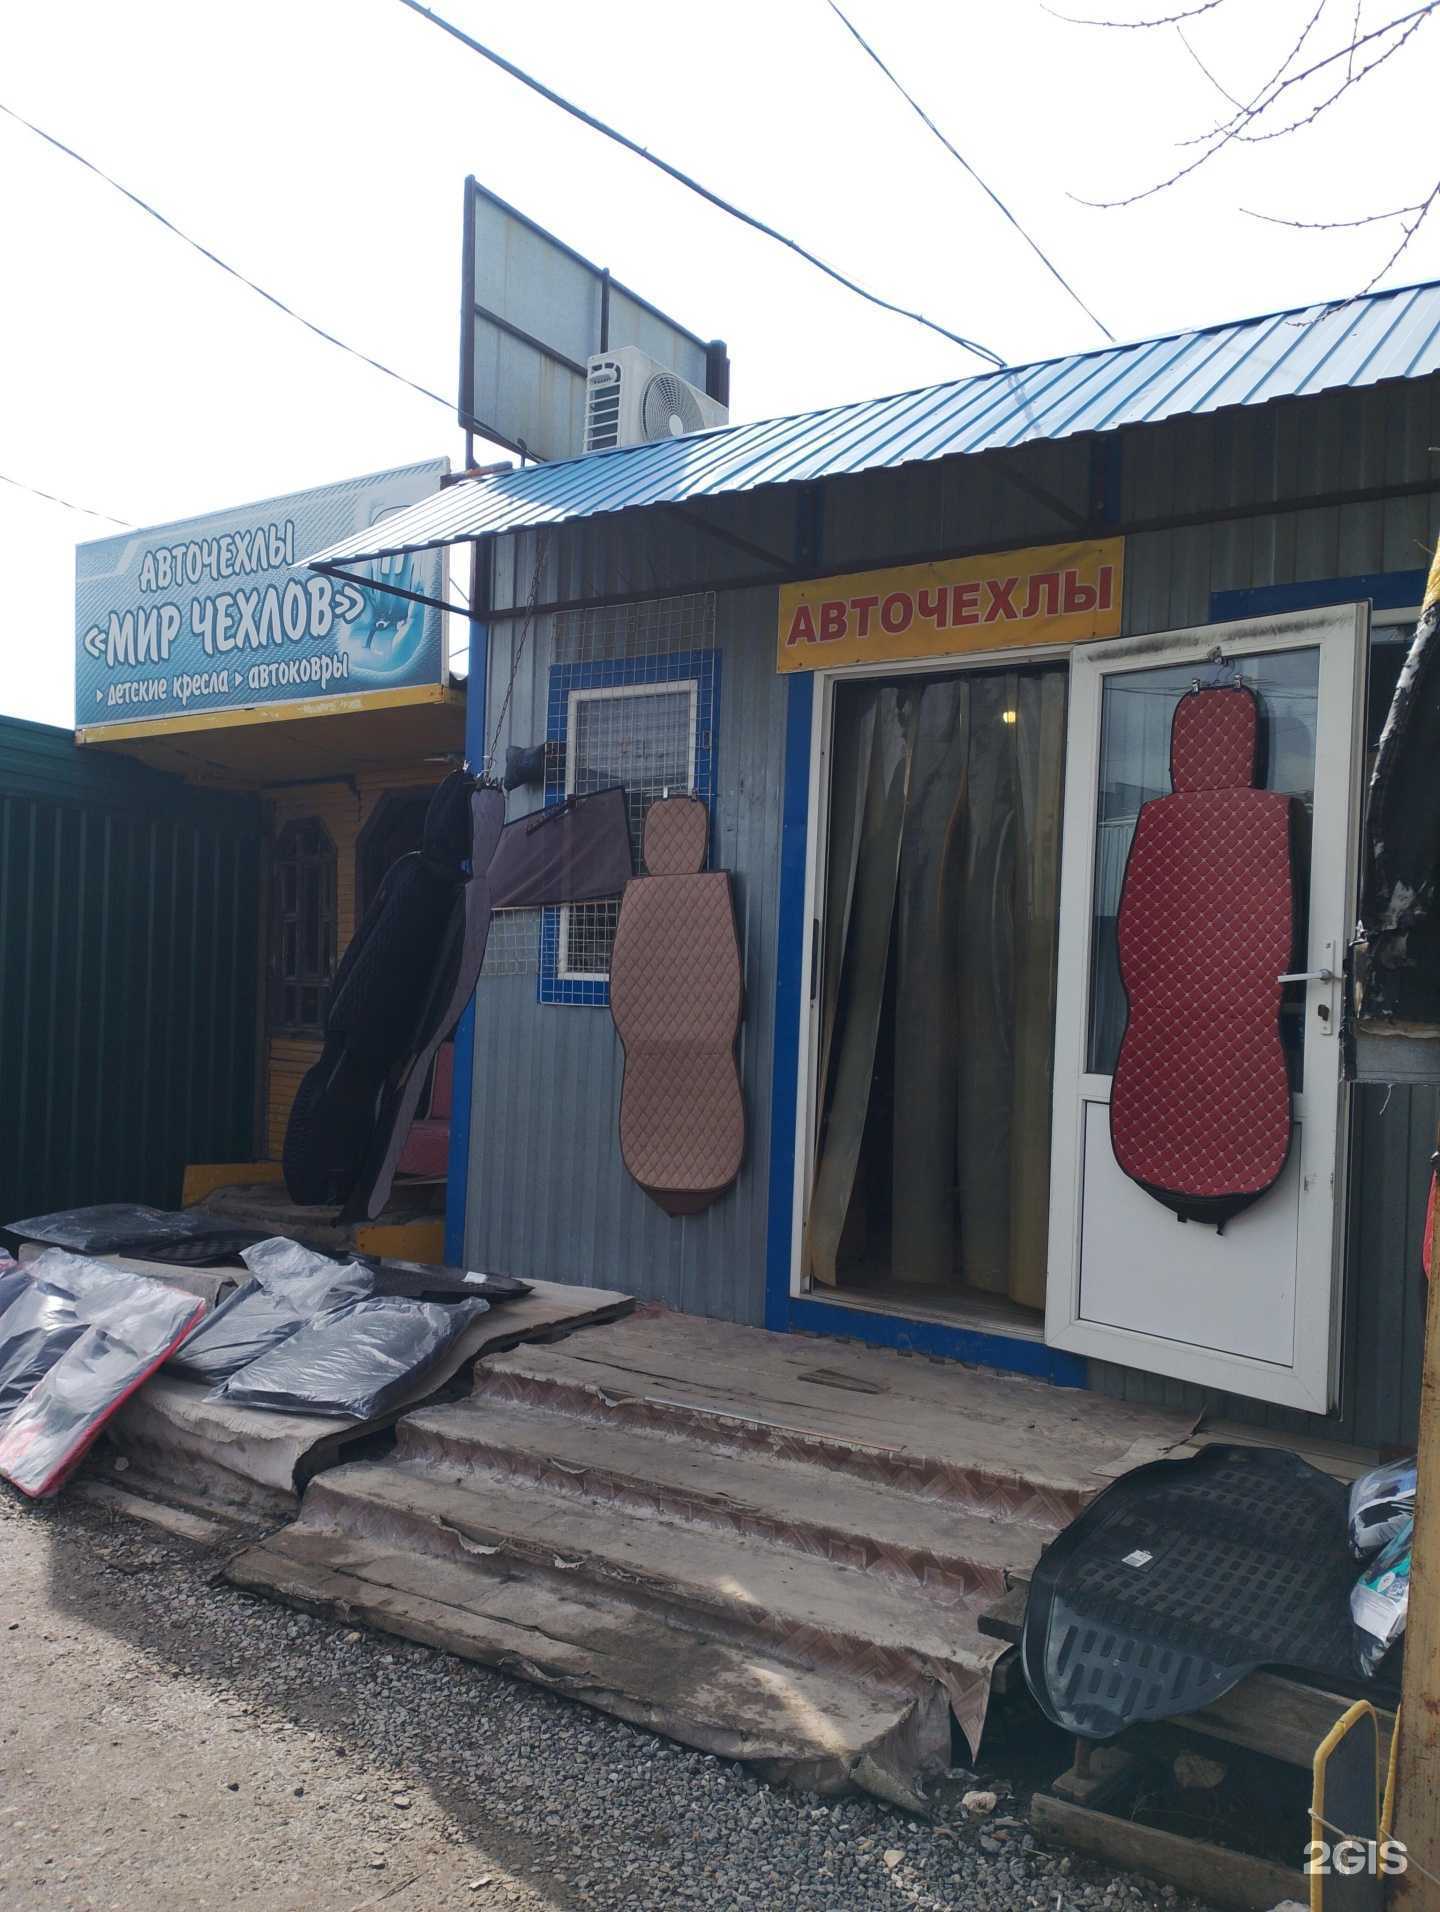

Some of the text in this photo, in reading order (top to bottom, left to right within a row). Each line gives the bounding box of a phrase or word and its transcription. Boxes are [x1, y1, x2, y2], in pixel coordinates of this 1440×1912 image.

[139, 520, 295, 592] АВТОЧЕХЛЫ
[84, 576, 365, 667] «МИР ЧЕХЛОВ»
[786, 565, 1113, 646] АВТОЧЕХЛЫ
[172, 670, 229, 705] кресла
[249, 653, 348, 689] автоковры
